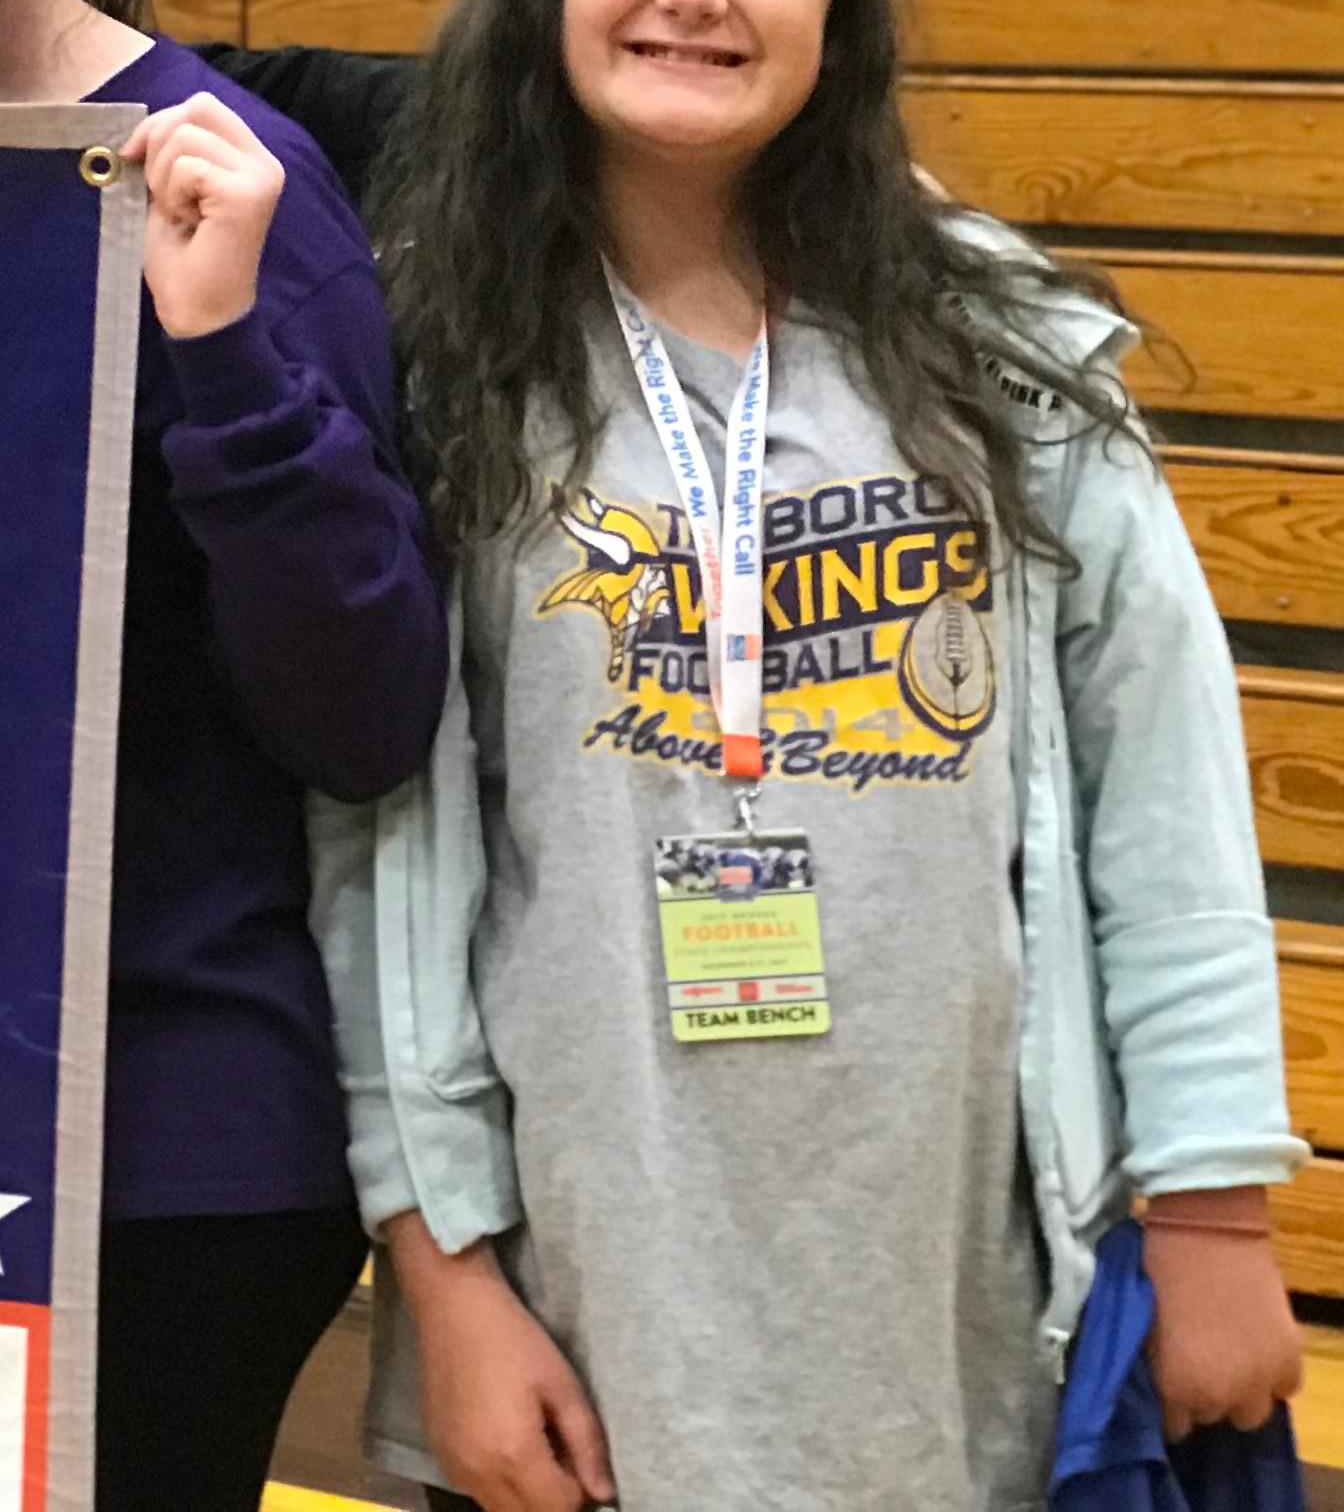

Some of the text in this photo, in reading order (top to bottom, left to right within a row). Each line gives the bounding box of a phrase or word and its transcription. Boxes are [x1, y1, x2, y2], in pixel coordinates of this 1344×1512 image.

[657, 393, 679, 425] the
[671, 430, 699, 479] Make
[738, 429, 757, 463] the
[656, 473, 957, 549] TBORO
[689, 486, 706, 517] We
[733, 469, 757, 528] Right
[734, 534, 756, 576] Call
[671, 530, 988, 635] VKINGS
[629, 629, 893, 695] FOOBALL
[582, 704, 723, 770] Above
[780, 730, 971, 792] Beyond
[682, 921, 799, 942] FOOTBALL
[685, 1006, 816, 1028] TEAM BENCH
